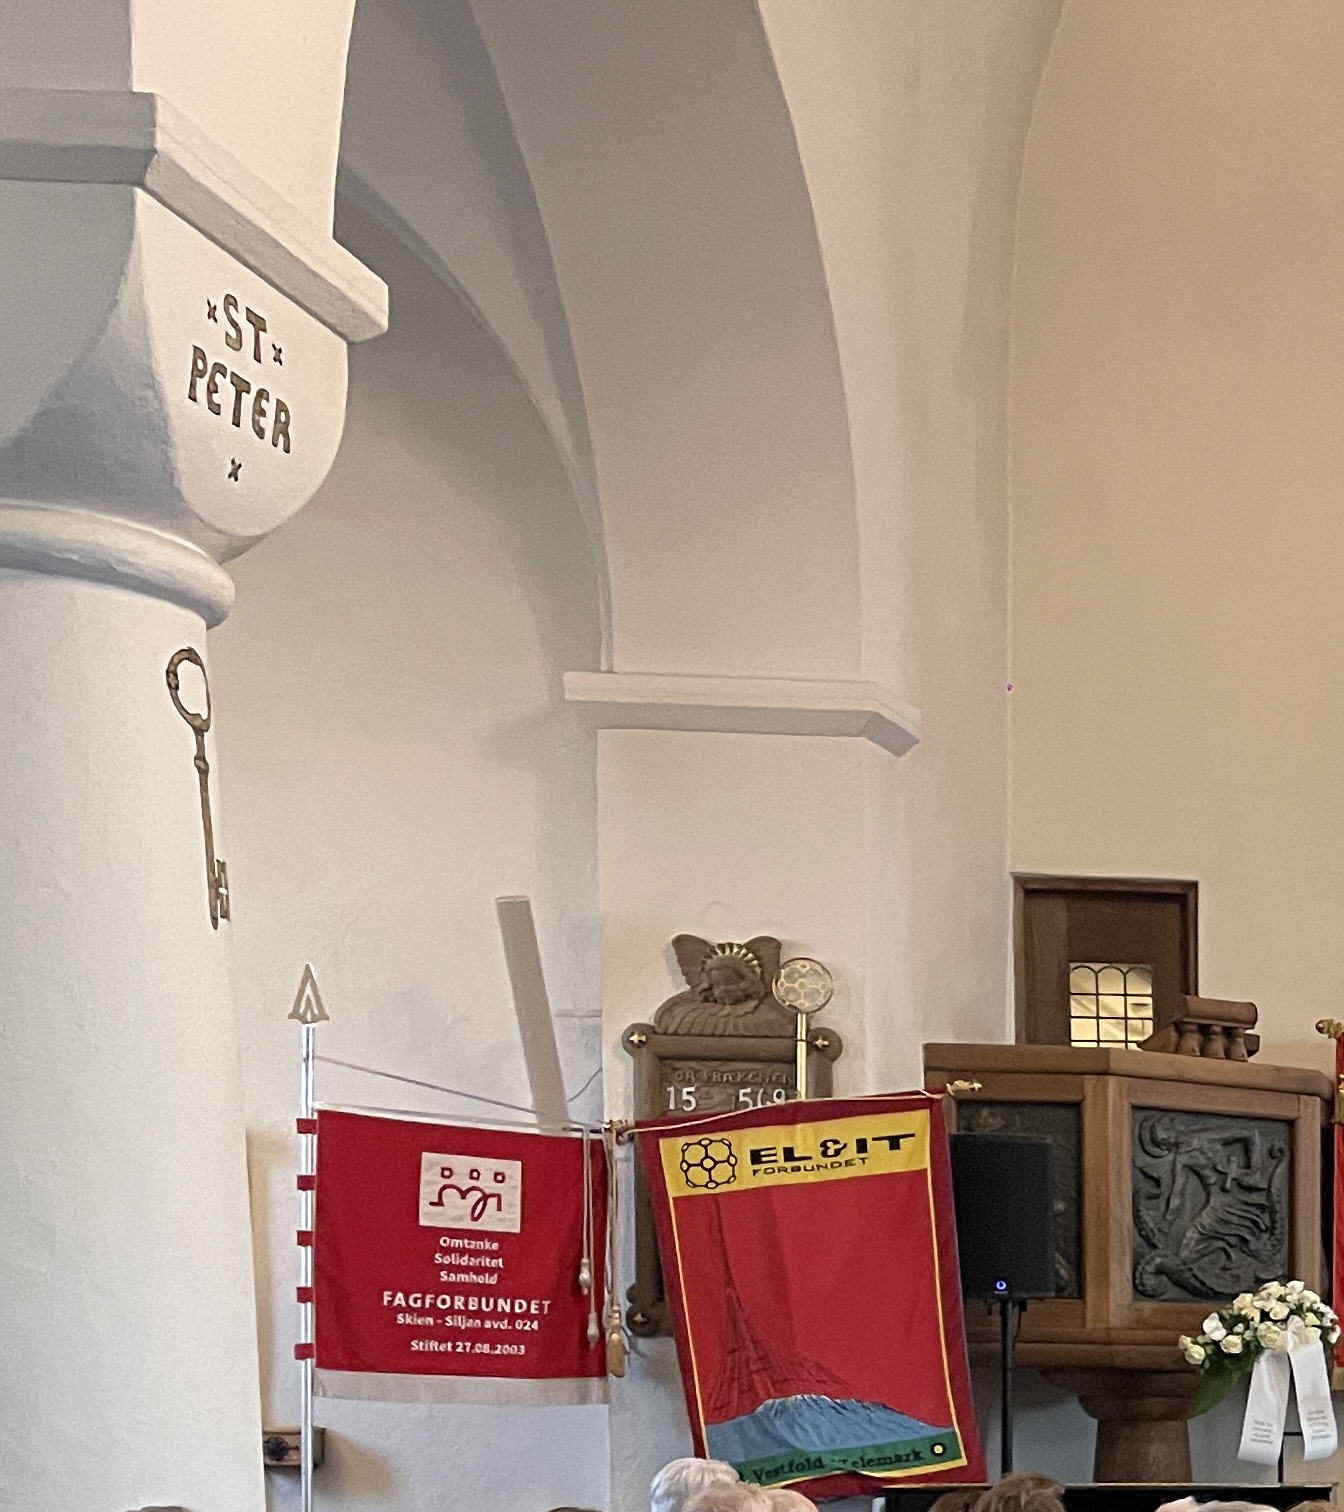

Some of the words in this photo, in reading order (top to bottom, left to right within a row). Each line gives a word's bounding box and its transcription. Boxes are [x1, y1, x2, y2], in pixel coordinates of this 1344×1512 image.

[223, 293, 267, 364] ST
[187, 344, 291, 454] PETER
[667, 1086, 698, 1111] 15
[750, 1133, 916, 1165] EL&IT
[752, 1157, 869, 1177] FORBUNDET
[439, 1236, 499, 1250] Omtanke
[434, 1252, 504, 1268] Solidaritet
[440, 1270, 498, 1285] Samhold
[382, 1291, 551, 1315] FAGFORBUNDET
[396, 1312, 434, 1326] Skien
[445, 1315, 481, 1329] Siljan
[515, 1319, 539, 1331] 024
[410, 1339, 452, 1352] Stiftet
[753, 1456, 825, 1483] Vestfold
